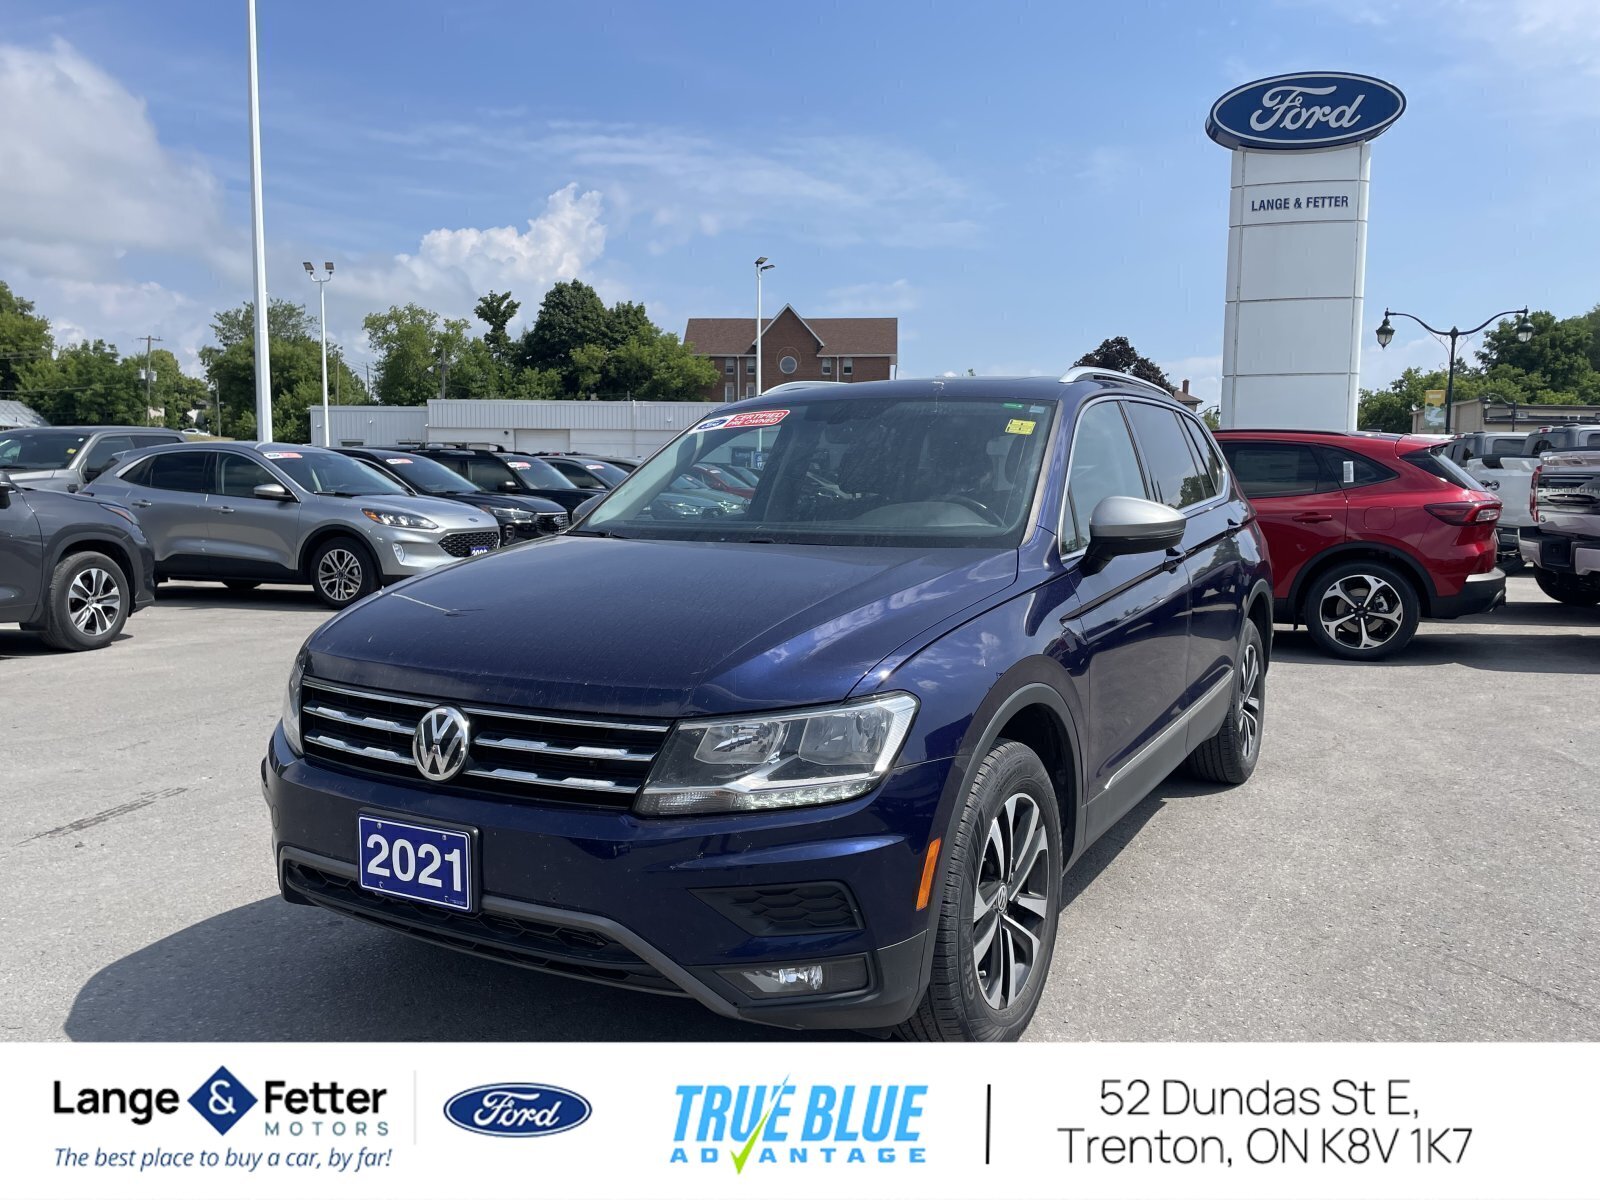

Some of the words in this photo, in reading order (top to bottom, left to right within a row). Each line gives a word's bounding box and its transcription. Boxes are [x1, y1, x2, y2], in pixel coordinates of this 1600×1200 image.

[1250, 86, 1366, 132] Ford
[1251, 197, 1290, 212] LANGE
[1293, 197, 1302, 209] &
[1306, 195, 1349, 209] FETTER
[734, 412, 784, 420] CERTIFIED
[366, 834, 461, 892] 2021
